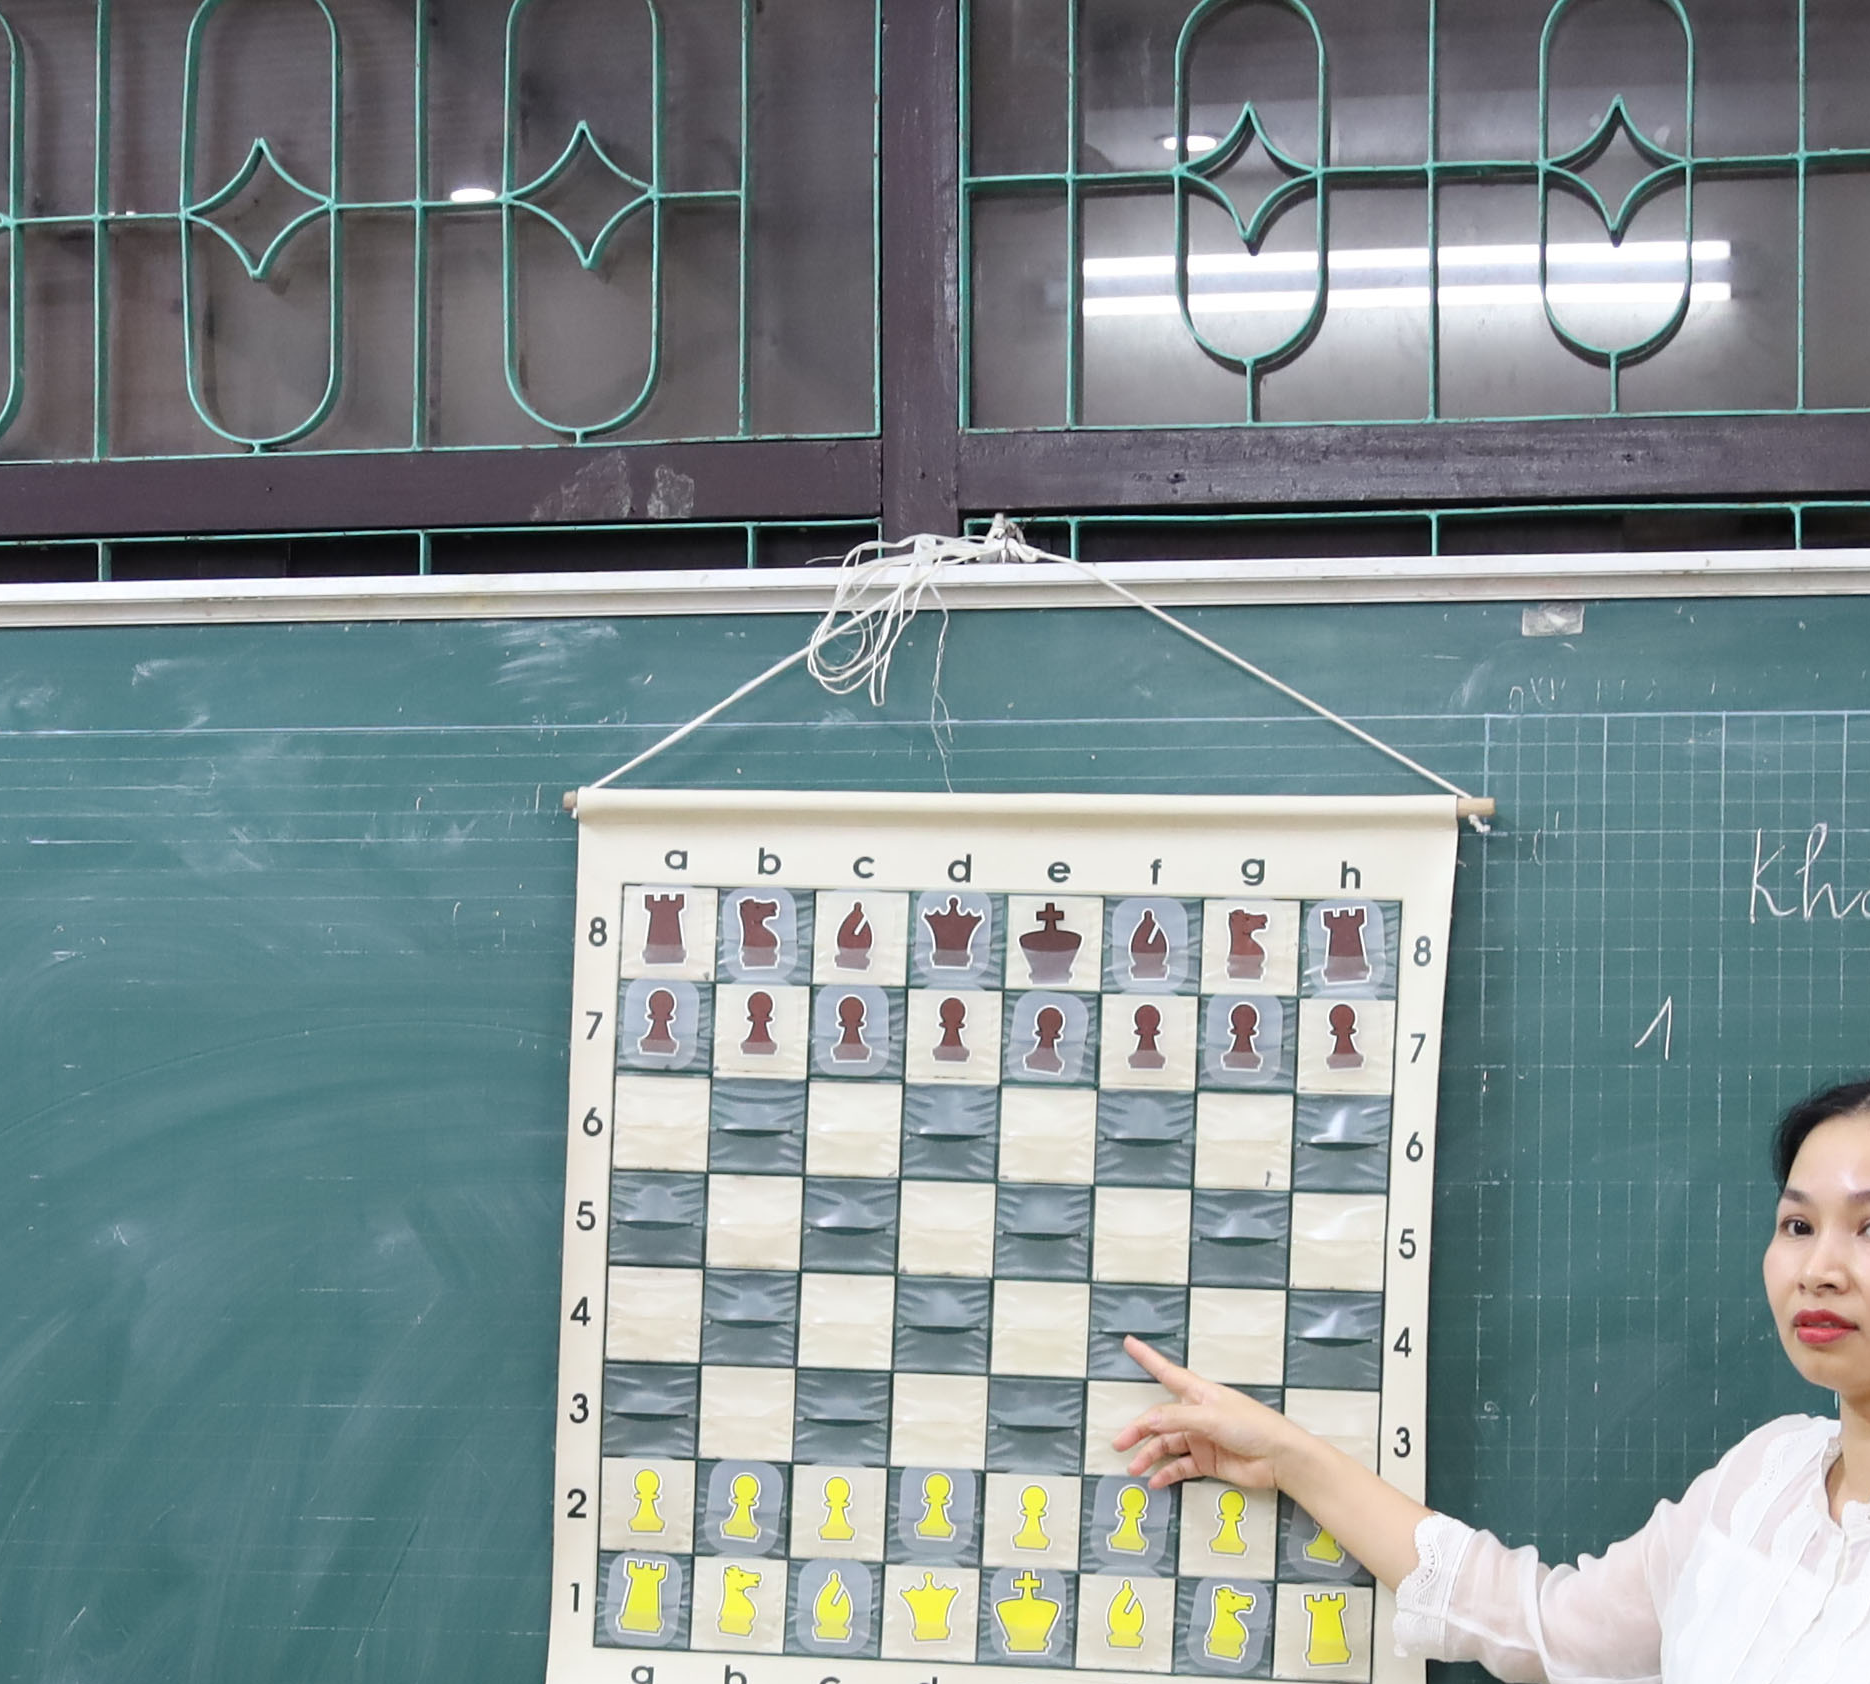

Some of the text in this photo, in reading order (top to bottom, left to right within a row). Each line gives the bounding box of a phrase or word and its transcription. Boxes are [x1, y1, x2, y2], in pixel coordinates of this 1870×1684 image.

[663, 846, 1362, 891] a b c d e f g h
[587, 915, 609, 949] 8
[1412, 934, 1433, 968] 8
[584, 1009, 604, 1042] 7
[1633, 994, 1673, 1062] 1
[1409, 1032, 1427, 1064] 7
[581, 1105, 605, 1138] 6
[1404, 1130, 1425, 1164] 6
[574, 1199, 597, 1233] 5
[1397, 1227, 1418, 1261] 5
[568, 1295, 593, 1328] 4
[1392, 1325, 1413, 1359] 4
[568, 1392, 590, 1425] 3
[1392, 1425, 1412, 1460] 3
[566, 1487, 588, 1520] 2
[569, 1581, 581, 1614] 1
